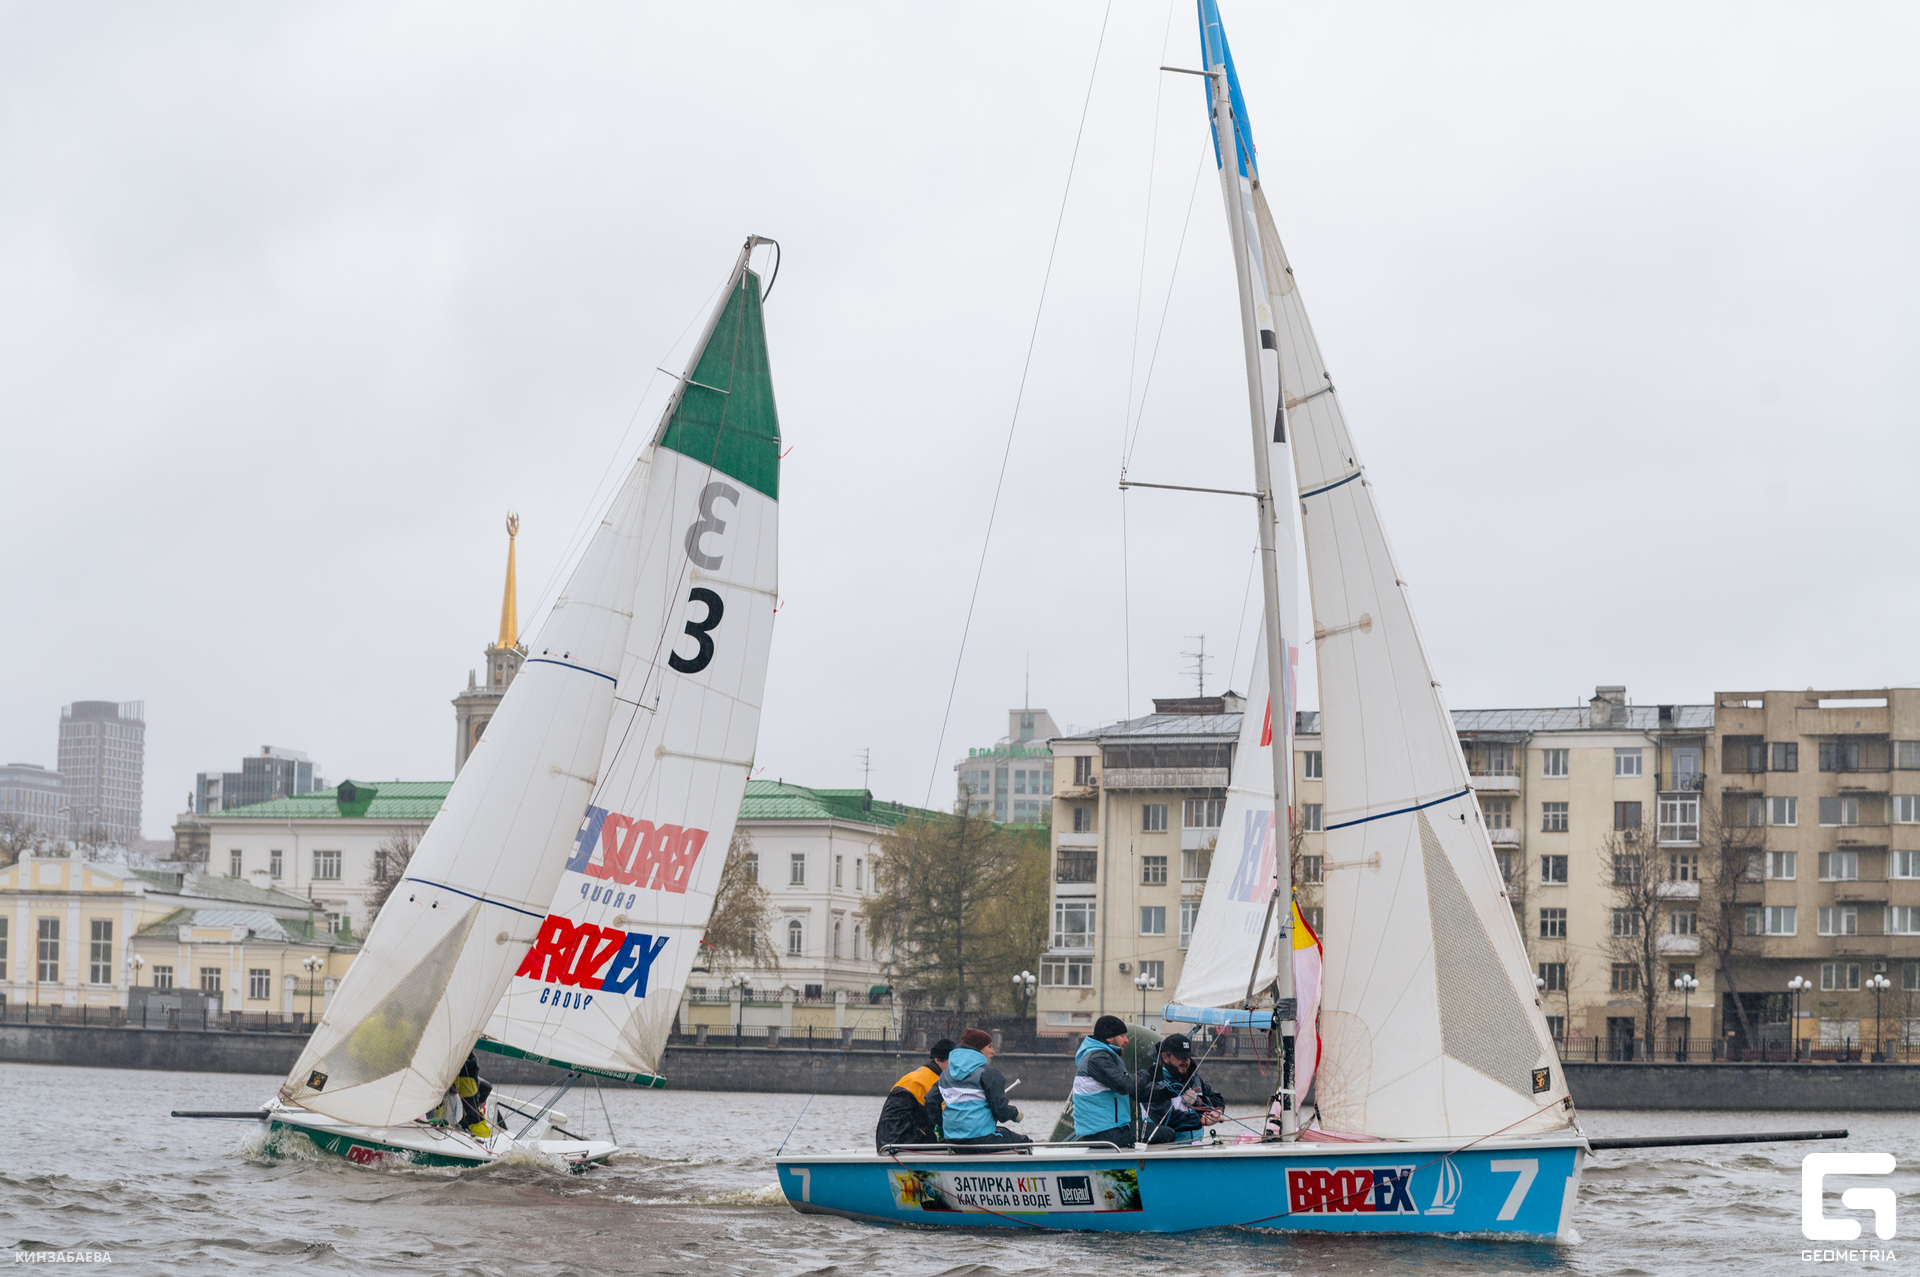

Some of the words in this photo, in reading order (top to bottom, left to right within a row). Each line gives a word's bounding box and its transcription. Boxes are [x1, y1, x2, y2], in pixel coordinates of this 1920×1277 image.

[668, 587, 725, 674] 3
[540, 988, 593, 1010] GROUP
[789, 1168, 811, 1202] 7
[954, 1176, 1015, 1193] ЗАТИРКА
[1017, 1177, 1047, 1192] KITT
[1059, 1177, 1091, 1203] bergauf
[1490, 1158, 1539, 1221] 7
[957, 1194, 979, 1206] КАК
[979, 1194, 1011, 1206] РЫБА
[1012, 1194, 1020, 1206] В
[1022, 1194, 1052, 1208] ВОДЕ
